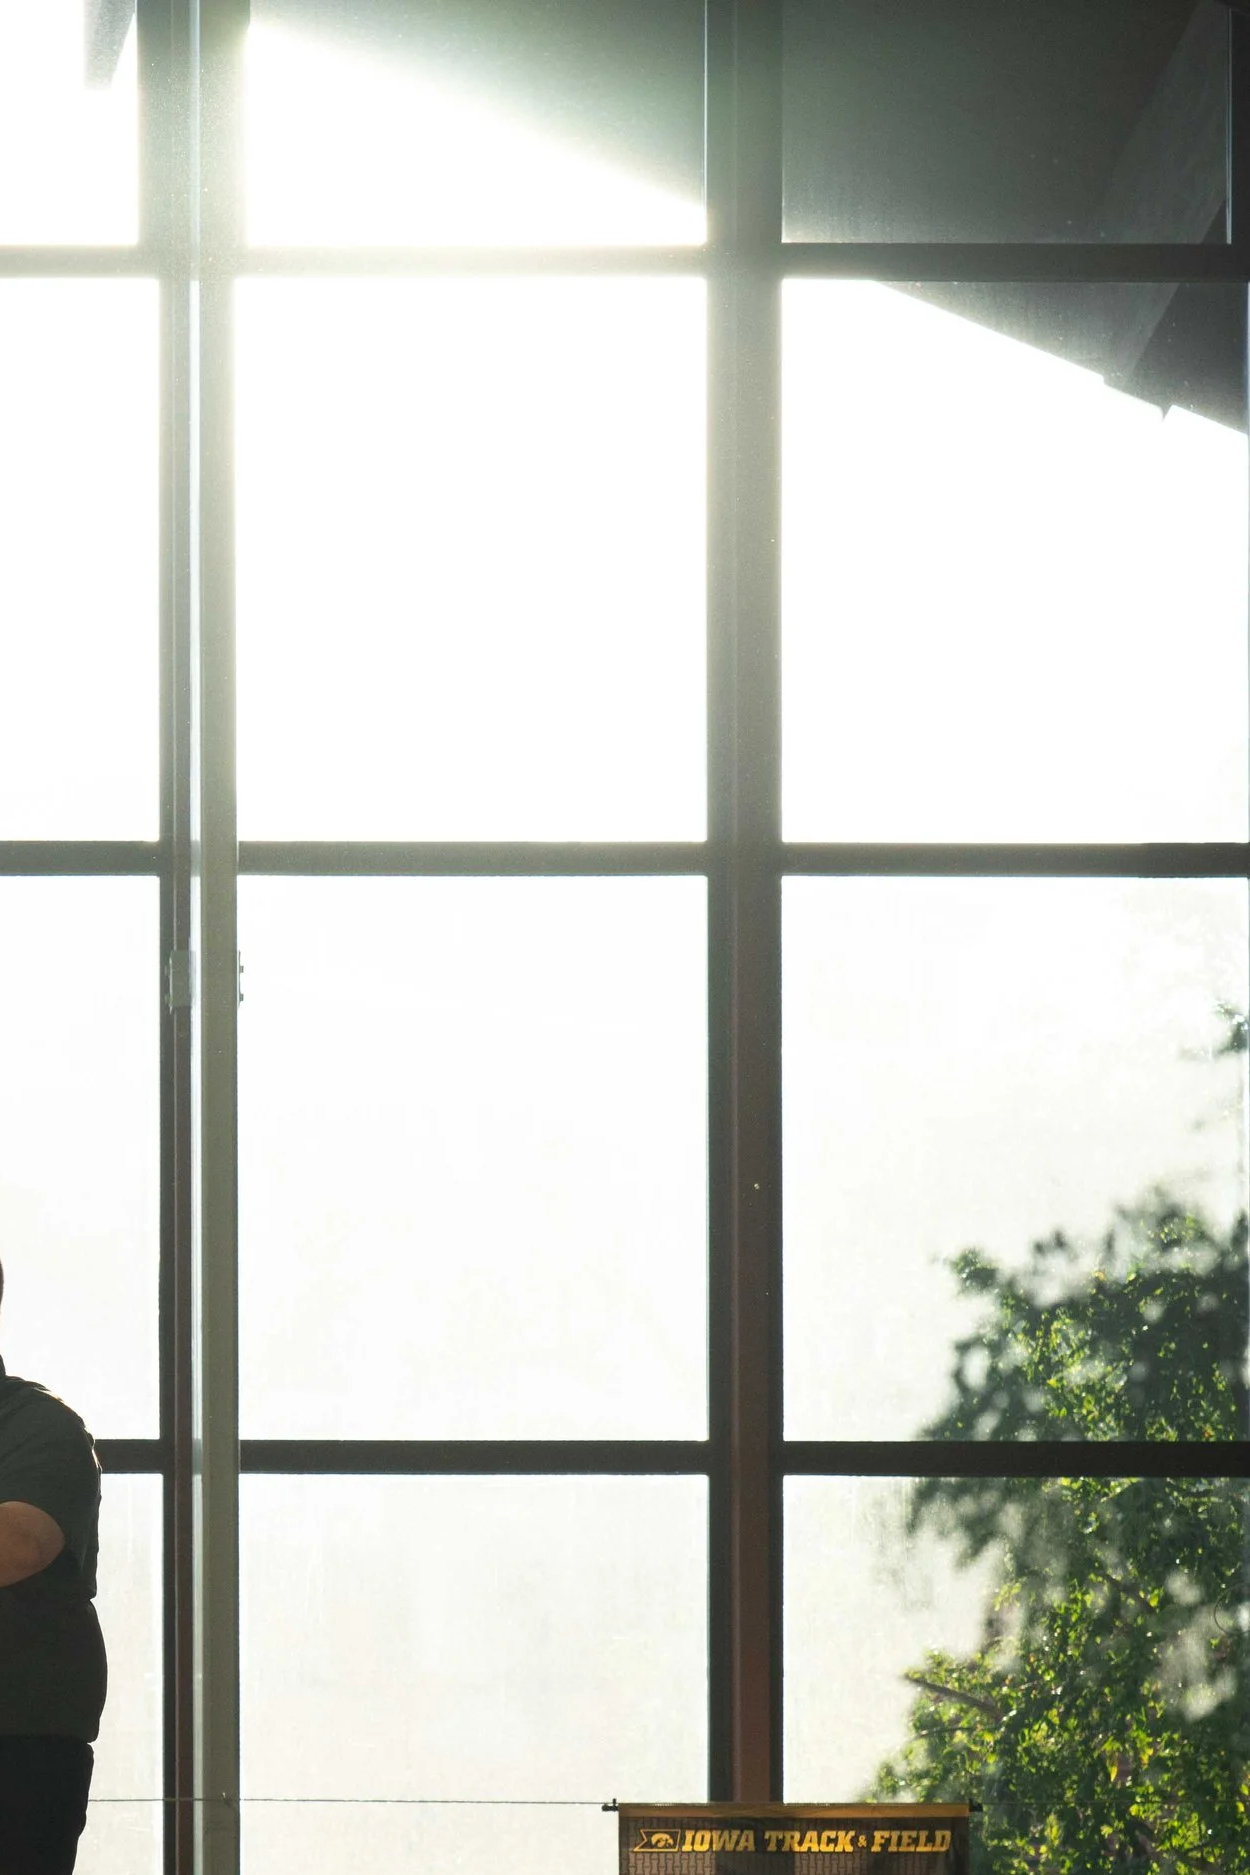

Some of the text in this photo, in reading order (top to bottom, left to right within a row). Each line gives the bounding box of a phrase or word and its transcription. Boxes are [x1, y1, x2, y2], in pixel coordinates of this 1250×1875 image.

[681, 1830, 951, 1852] IOWA TRACK & FIELD
